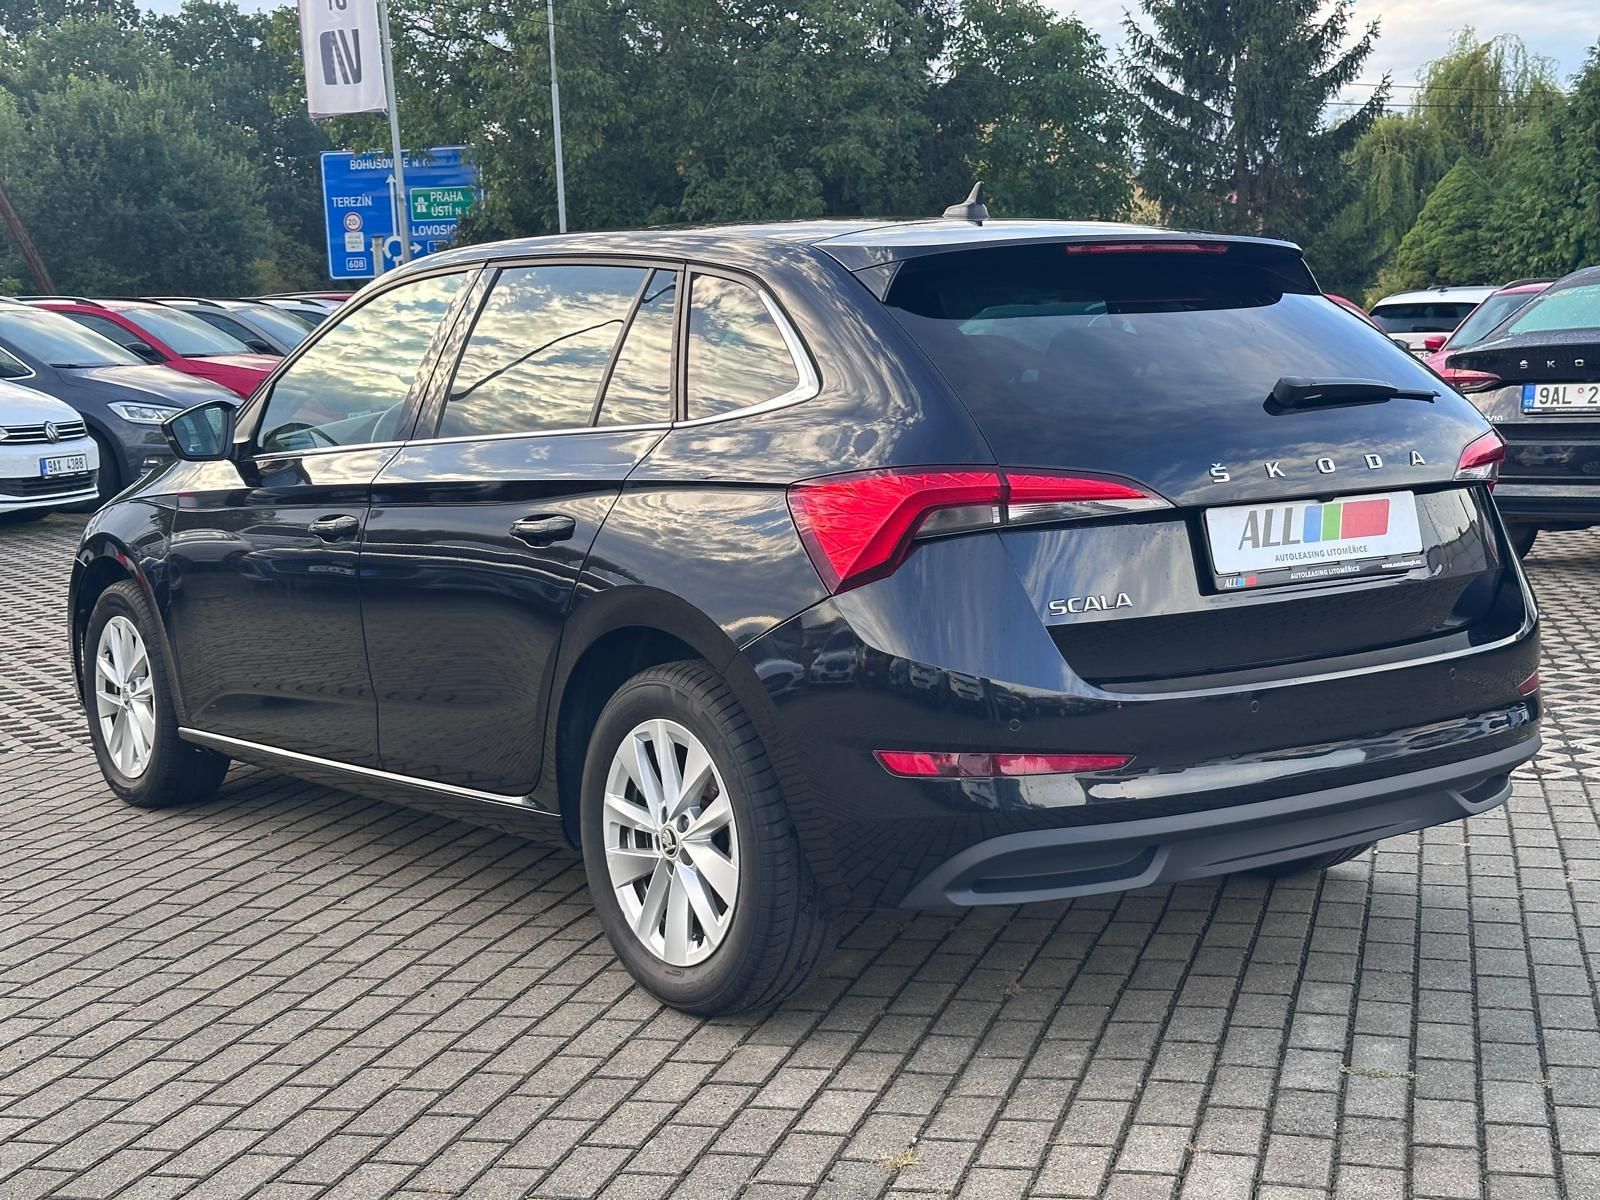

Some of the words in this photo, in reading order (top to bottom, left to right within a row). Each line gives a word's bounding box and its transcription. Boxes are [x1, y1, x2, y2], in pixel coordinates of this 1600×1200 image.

[350, 157, 409, 170] BOHUŠOVE
[332, 194, 372, 207] TEREZÍN
[430, 191, 464, 202] PRAHA
[431, 203, 453, 216] ÚSTÍ
[412, 224, 458, 236] LOVOSIC
[348, 259, 364, 269] 608
[1539, 386, 1572, 405] 9AL
[1587, 386, 1599, 404] 2
[48, 459, 62, 472] 9AX
[1209, 450, 1426, 483] ŠKODA
[1238, 507, 1300, 550] ALL
[1275, 549, 1325, 562] AUTOLEASING
[1326, 545, 1368, 558] LITOMĚŘICE
[1290, 568, 1328, 580] AUTOLEASING
[1328, 565, 1360, 575] LITOMĚŘICE
[1224, 578, 1237, 589] ALL
[1049, 592, 1133, 616] SCALA
